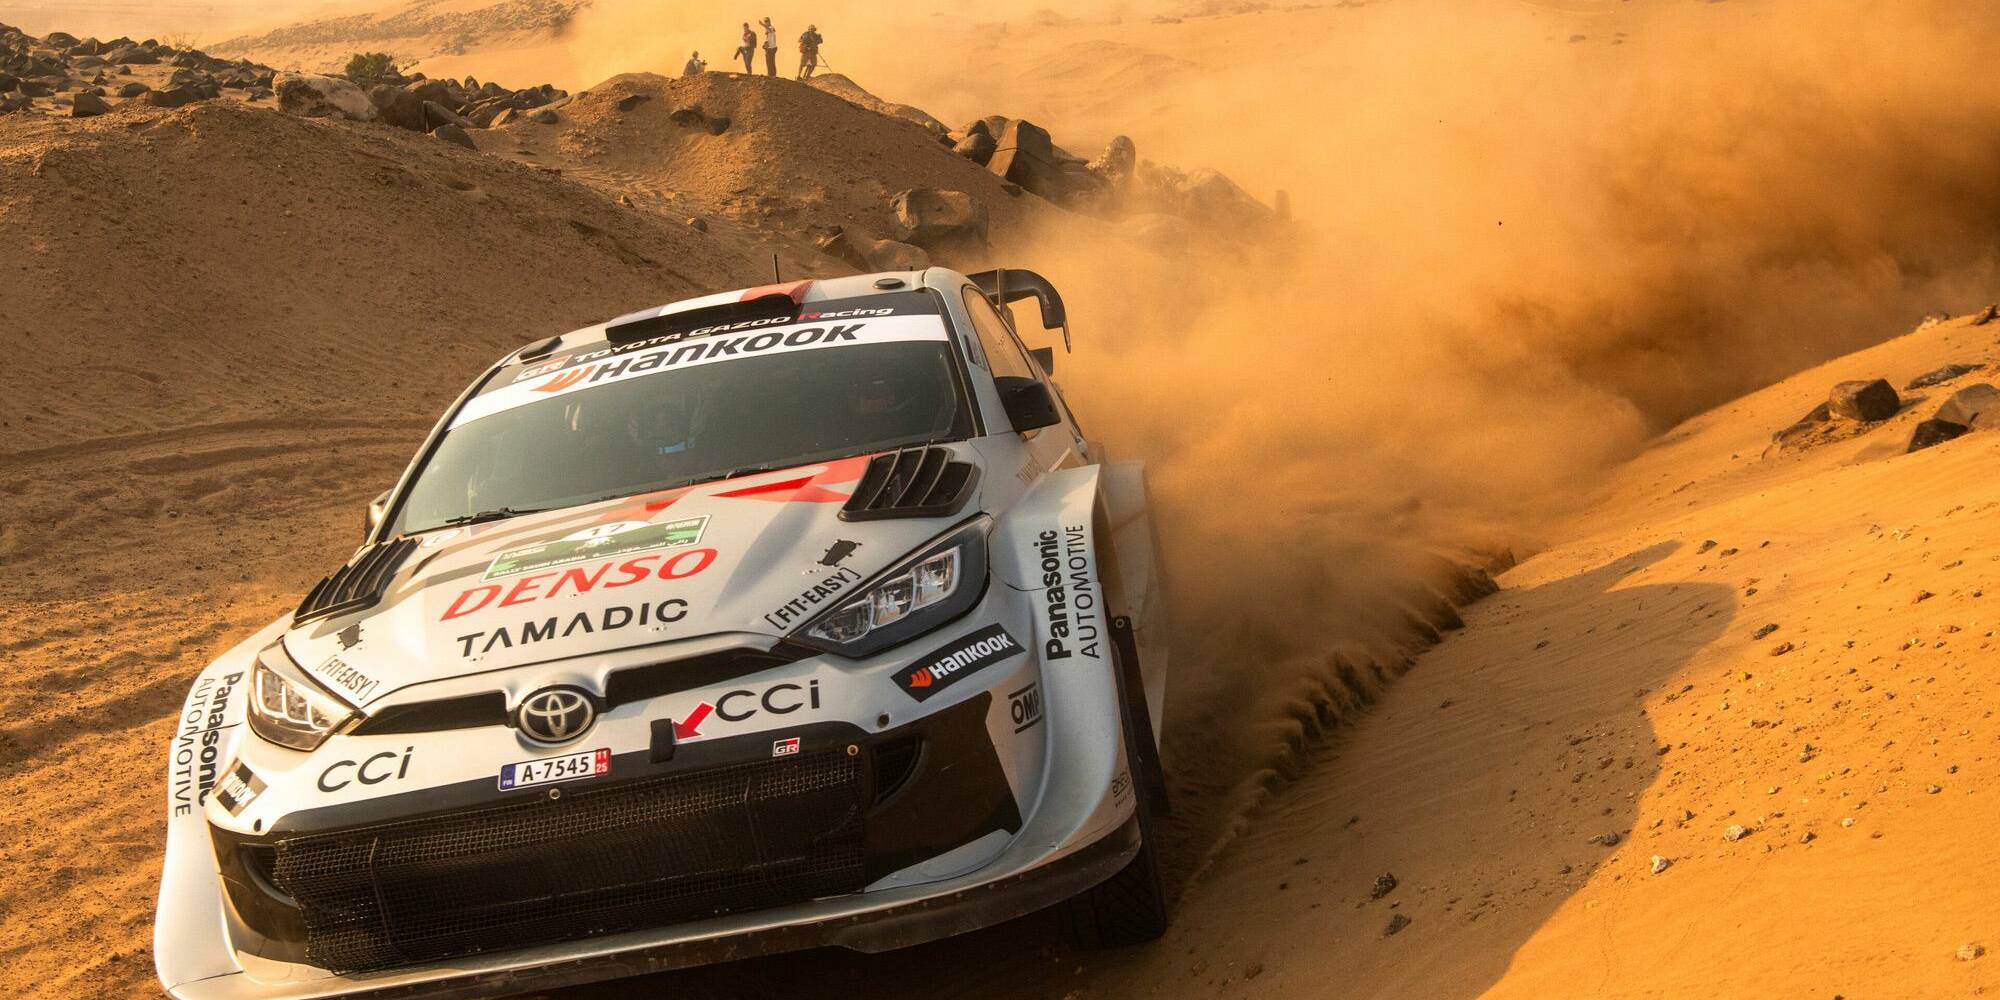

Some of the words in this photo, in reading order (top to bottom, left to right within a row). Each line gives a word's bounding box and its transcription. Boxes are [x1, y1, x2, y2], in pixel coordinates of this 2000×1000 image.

[575, 333, 681, 362] TOYOTA
[689, 316, 791, 337] GAZOO
[797, 308, 894, 321] Racing
[439, 547, 719, 621] DENSO
[1033, 529, 1072, 661] Panasonic
[1065, 524, 1100, 659] AUTOMOTIVE
[456, 598, 689, 657] TAMADIC
[1011, 689, 1041, 725] OMP
[174, 677, 215, 818] AUTOMOTIVE
[521, 756, 590, 783] A-7545
[595, 763, 608, 773] 25
[596, 750, 607, 760] 11
[775, 742, 799, 755] GR
